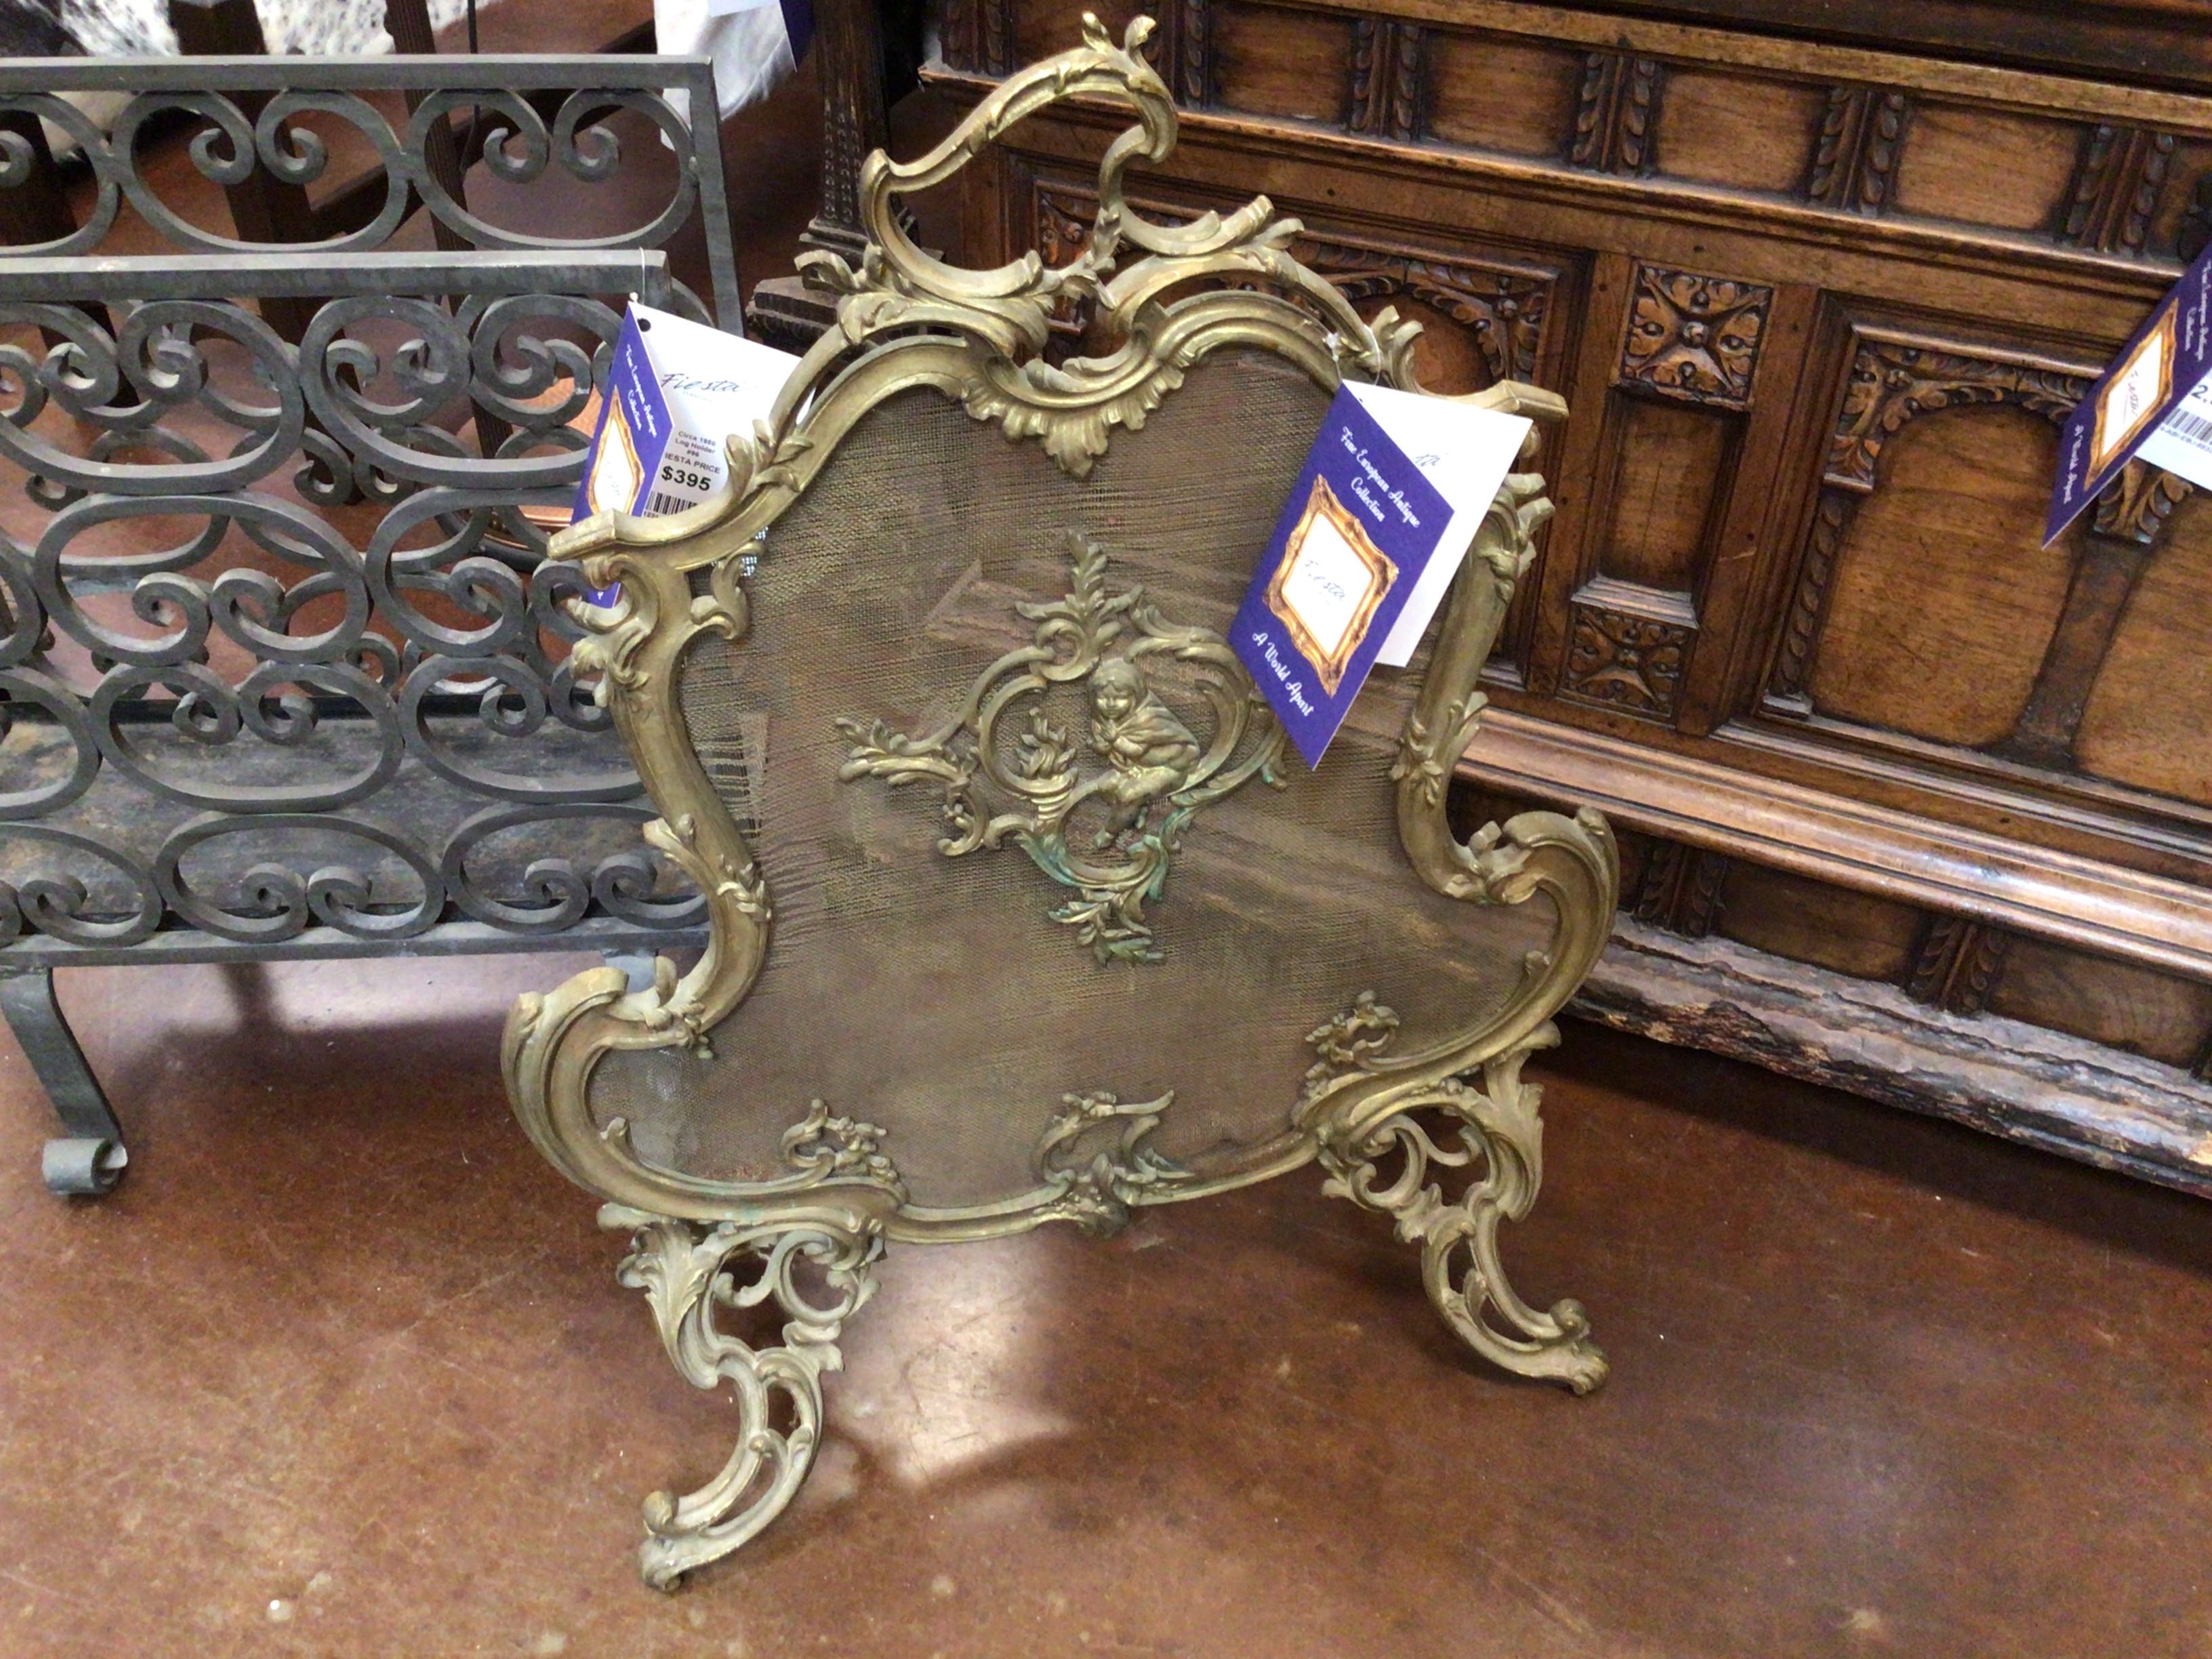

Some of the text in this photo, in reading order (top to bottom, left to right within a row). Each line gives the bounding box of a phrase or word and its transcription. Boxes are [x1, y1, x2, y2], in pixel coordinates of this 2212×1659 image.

[661, 373, 740, 392] Fiesta
[678, 431, 697, 441] Circa
[664, 452, 721, 474] IESTA PRICE
[661, 465, 712, 491] $395
[1340, 426, 1420, 528] Fine European Antique
[1351, 476, 1385, 523] Collection
[1252, 632, 1314, 716] A World Apart
